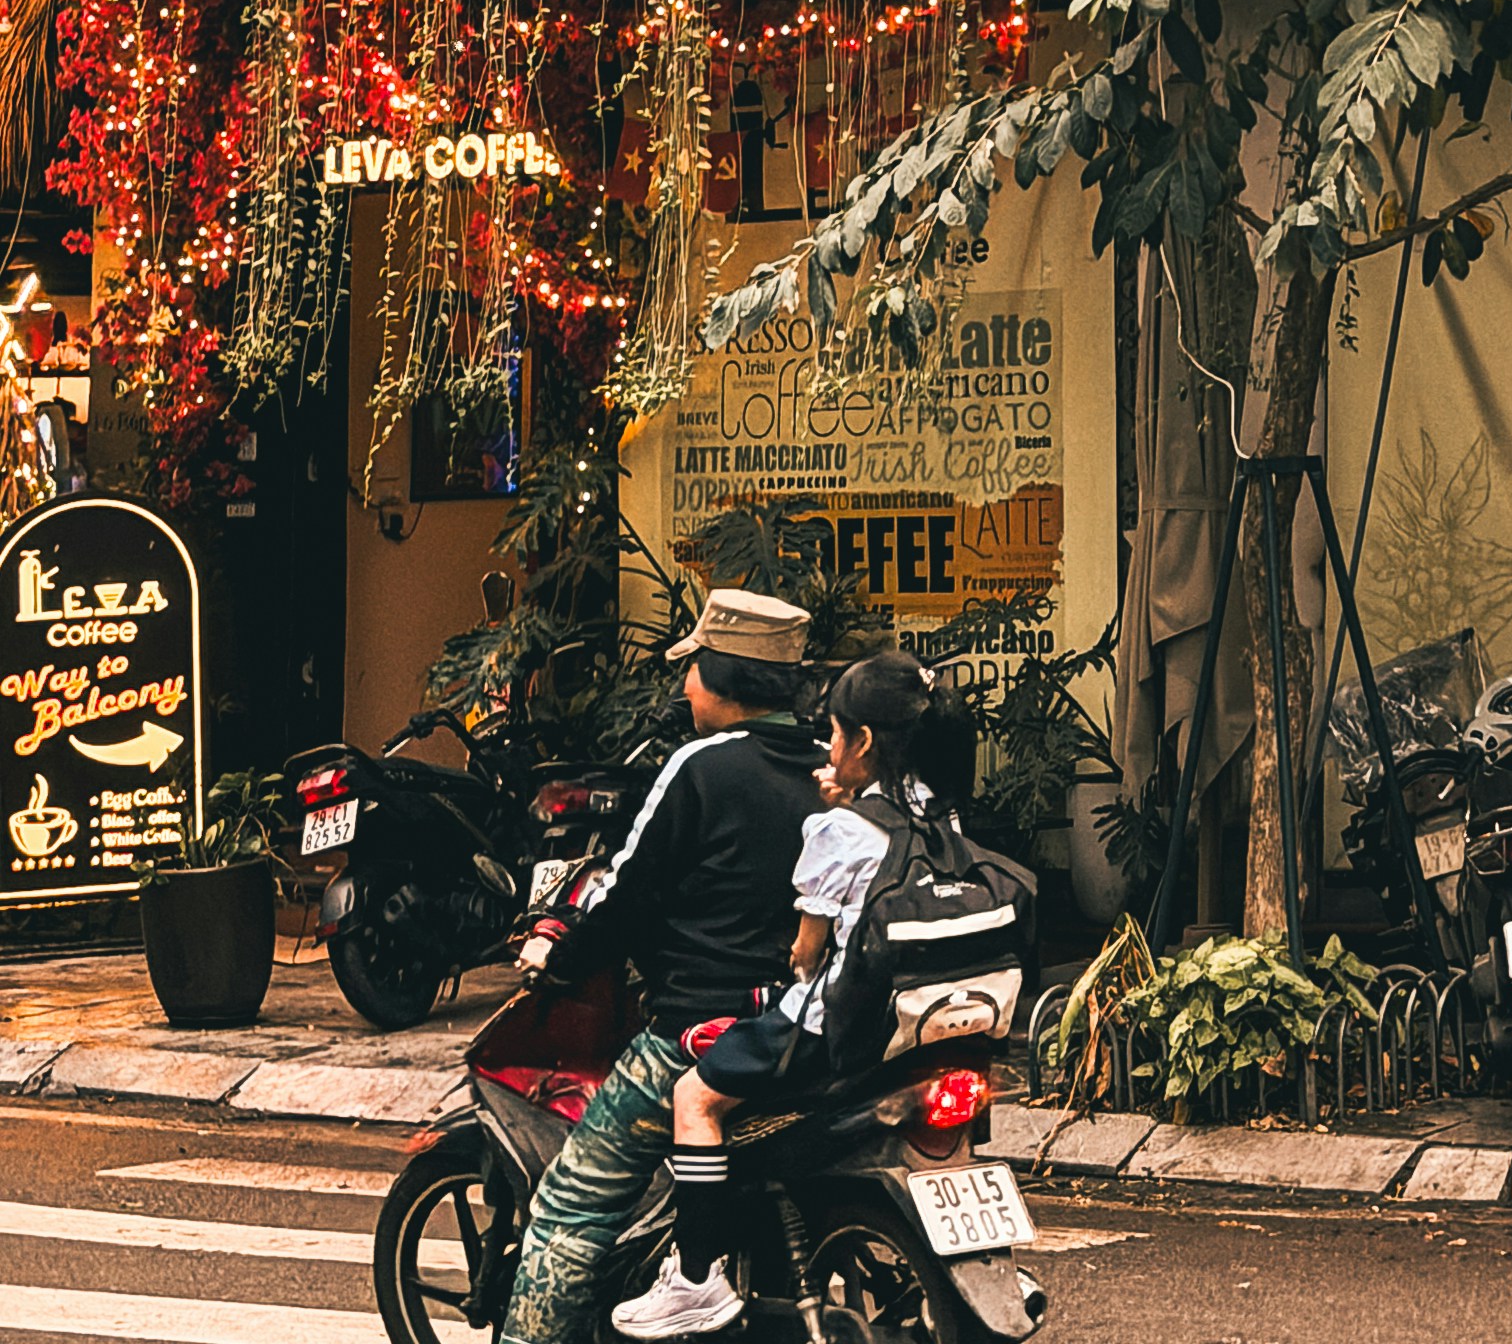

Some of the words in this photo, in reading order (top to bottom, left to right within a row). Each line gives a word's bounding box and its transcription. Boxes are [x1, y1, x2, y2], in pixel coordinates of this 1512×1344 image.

[325, 139, 414, 184] LEVA
[745, 359, 775, 375] Irish
[721, 357, 875, 439] Coffee
[674, 446, 731, 474] LATTE
[734, 443, 847, 473] MACCHIATO
[850, 432, 934, 484] Irish
[942, 436, 1052, 495] Coffee
[758, 475, 847, 491] CAPPUCCINO
[46, 620, 139, 648] Coffee
[0, 664, 91, 702] Way
[96, 655, 130, 680] to
[14, 674, 189, 758] Balcony
[101, 790, 133, 811] Egg
[926, 1170, 1004, 1210] 30-L5
[940, 1205, 1018, 1246] 3805
